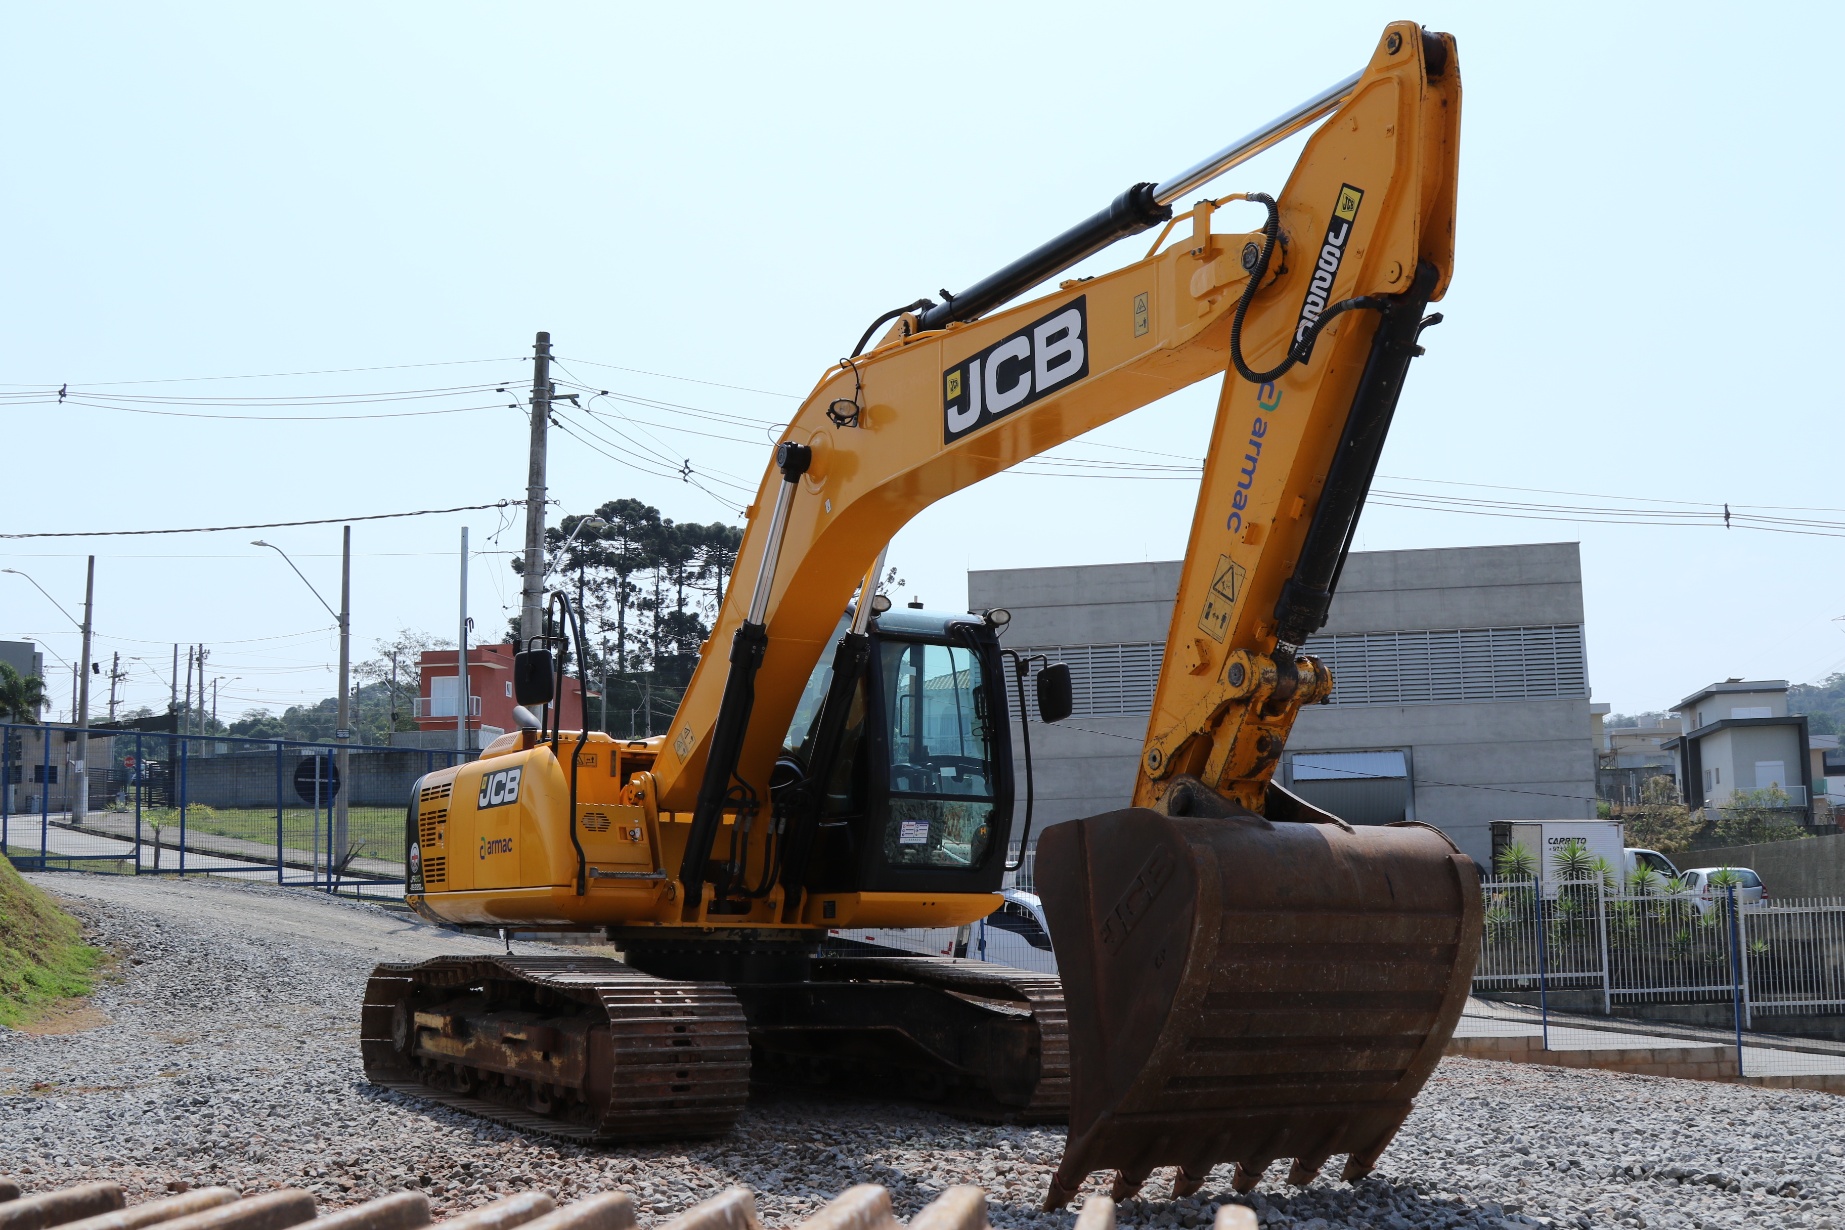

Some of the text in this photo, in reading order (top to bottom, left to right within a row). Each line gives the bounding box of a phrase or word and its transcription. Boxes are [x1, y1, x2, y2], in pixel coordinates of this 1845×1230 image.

[947, 308, 1085, 433] JCB
[1226, 416, 1268, 534] armac
[479, 768, 521, 807] JCB
[487, 838, 513, 855] armac
